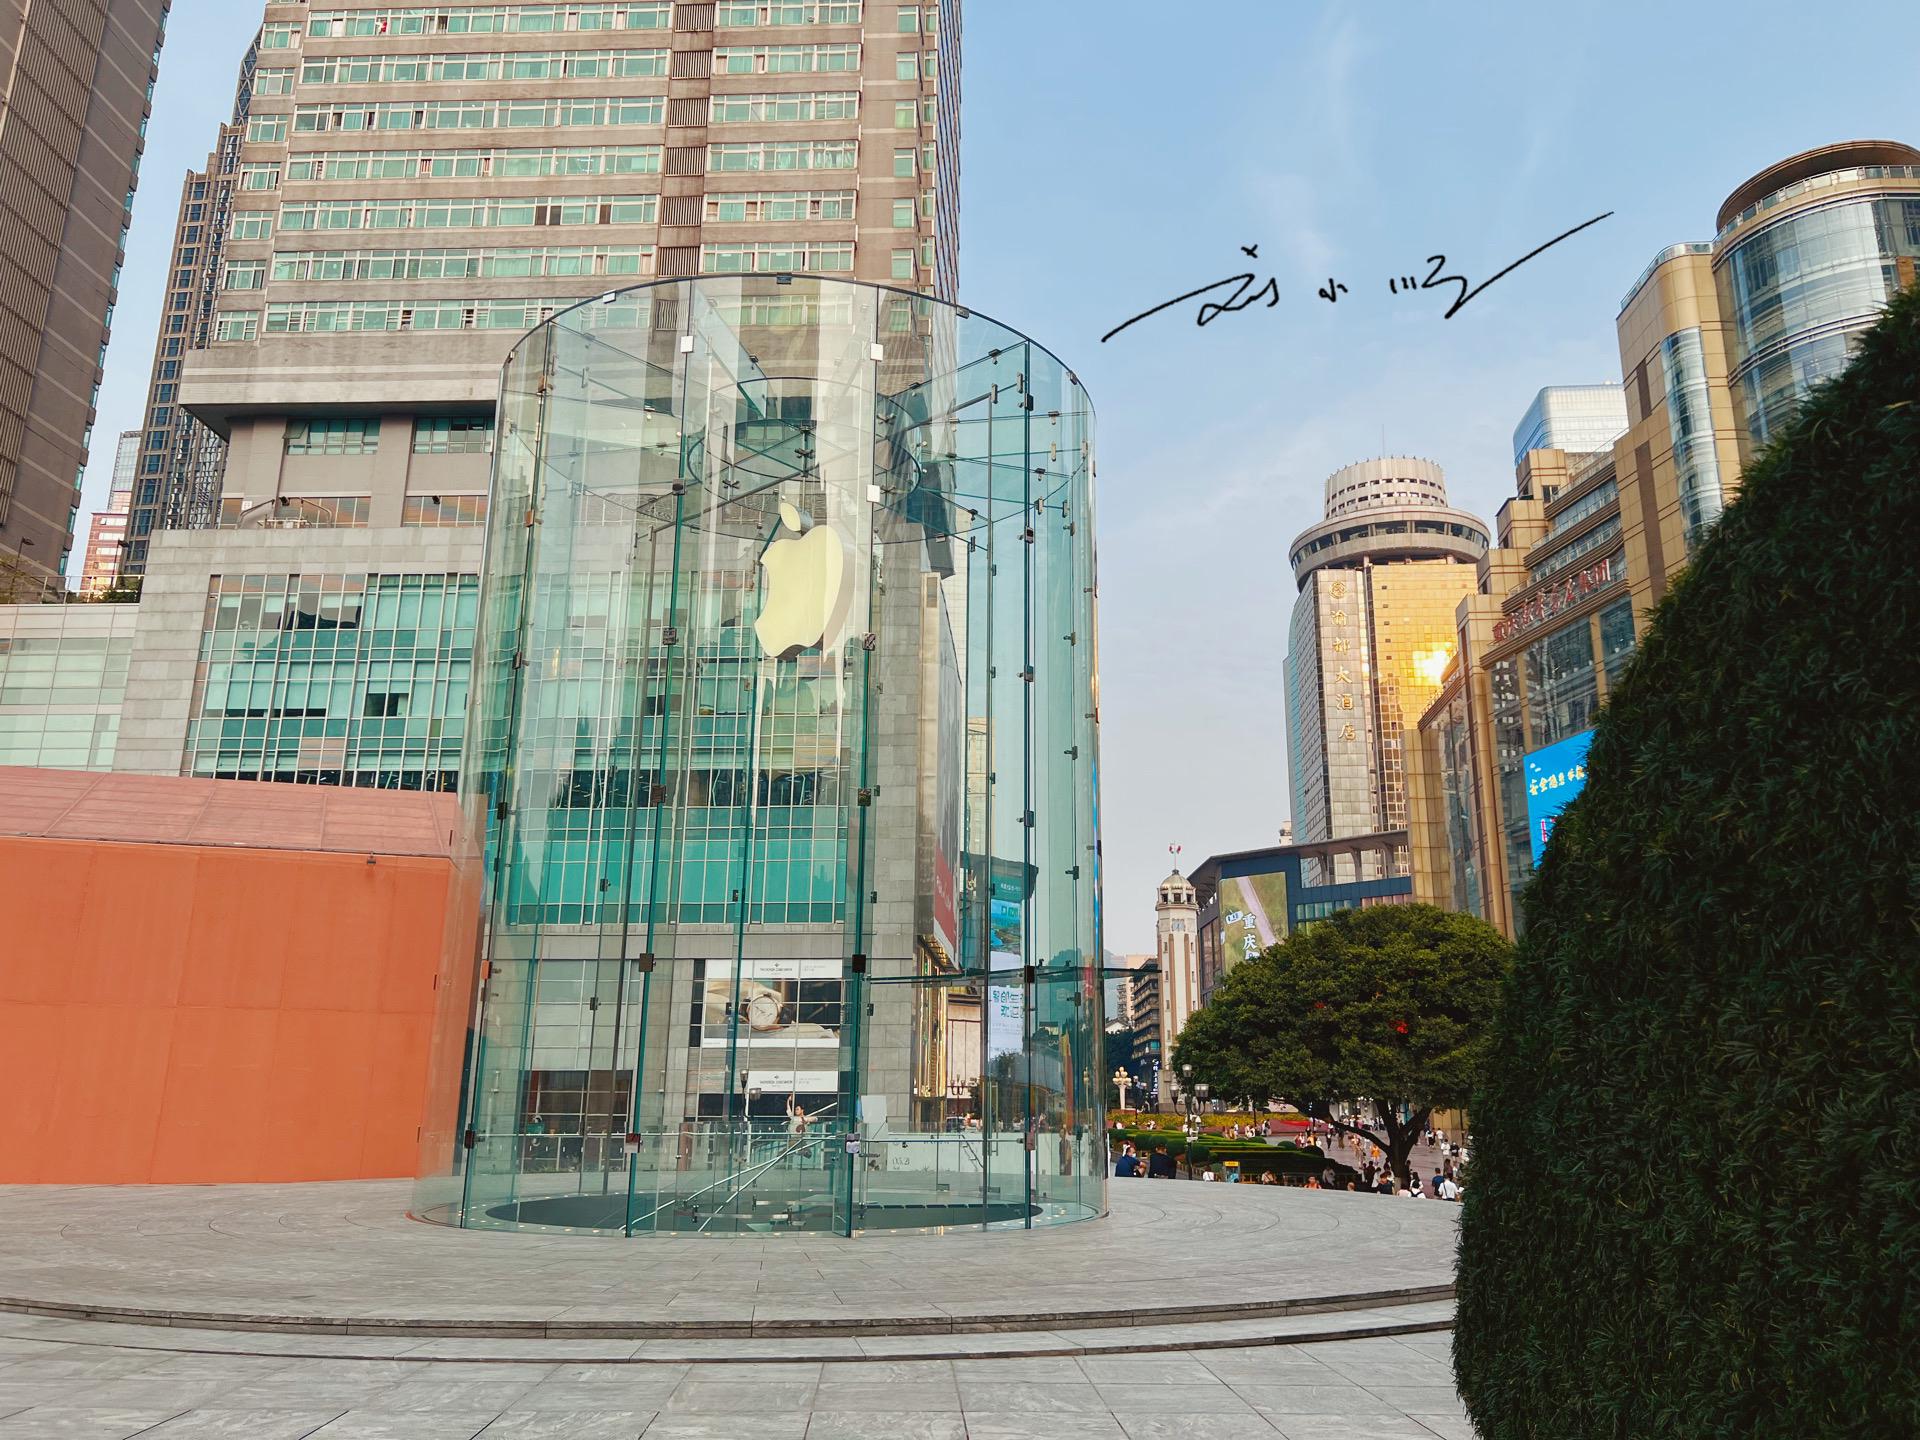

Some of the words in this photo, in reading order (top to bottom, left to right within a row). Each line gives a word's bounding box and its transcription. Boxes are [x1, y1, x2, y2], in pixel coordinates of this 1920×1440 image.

[1330, 610, 1356, 742] 渝都大酒店
